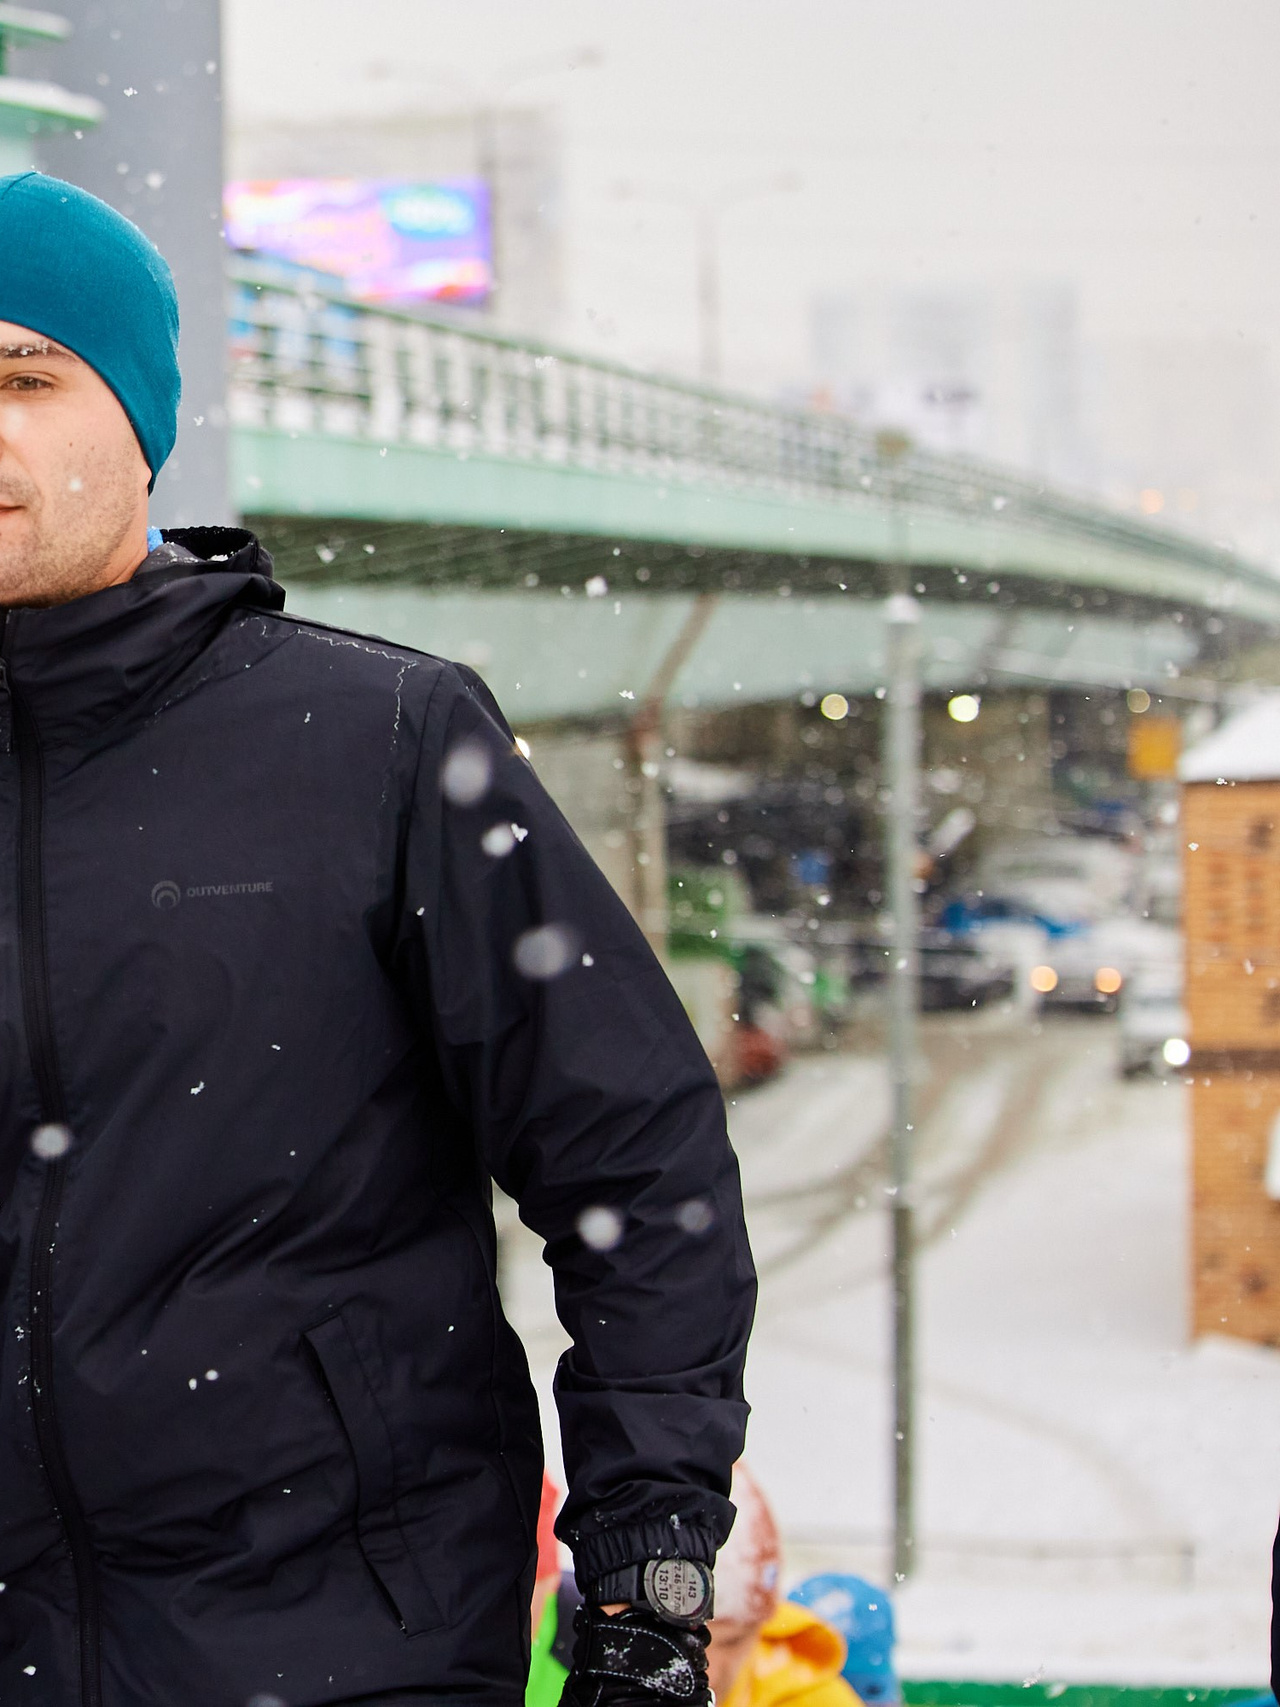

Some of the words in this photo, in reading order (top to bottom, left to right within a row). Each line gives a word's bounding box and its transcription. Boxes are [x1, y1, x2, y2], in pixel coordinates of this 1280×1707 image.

[187, 882, 273, 897] OUTVENTURE
[658, 1569, 669, 1600] 13:10
[688, 1580, 697, 1599] 143
